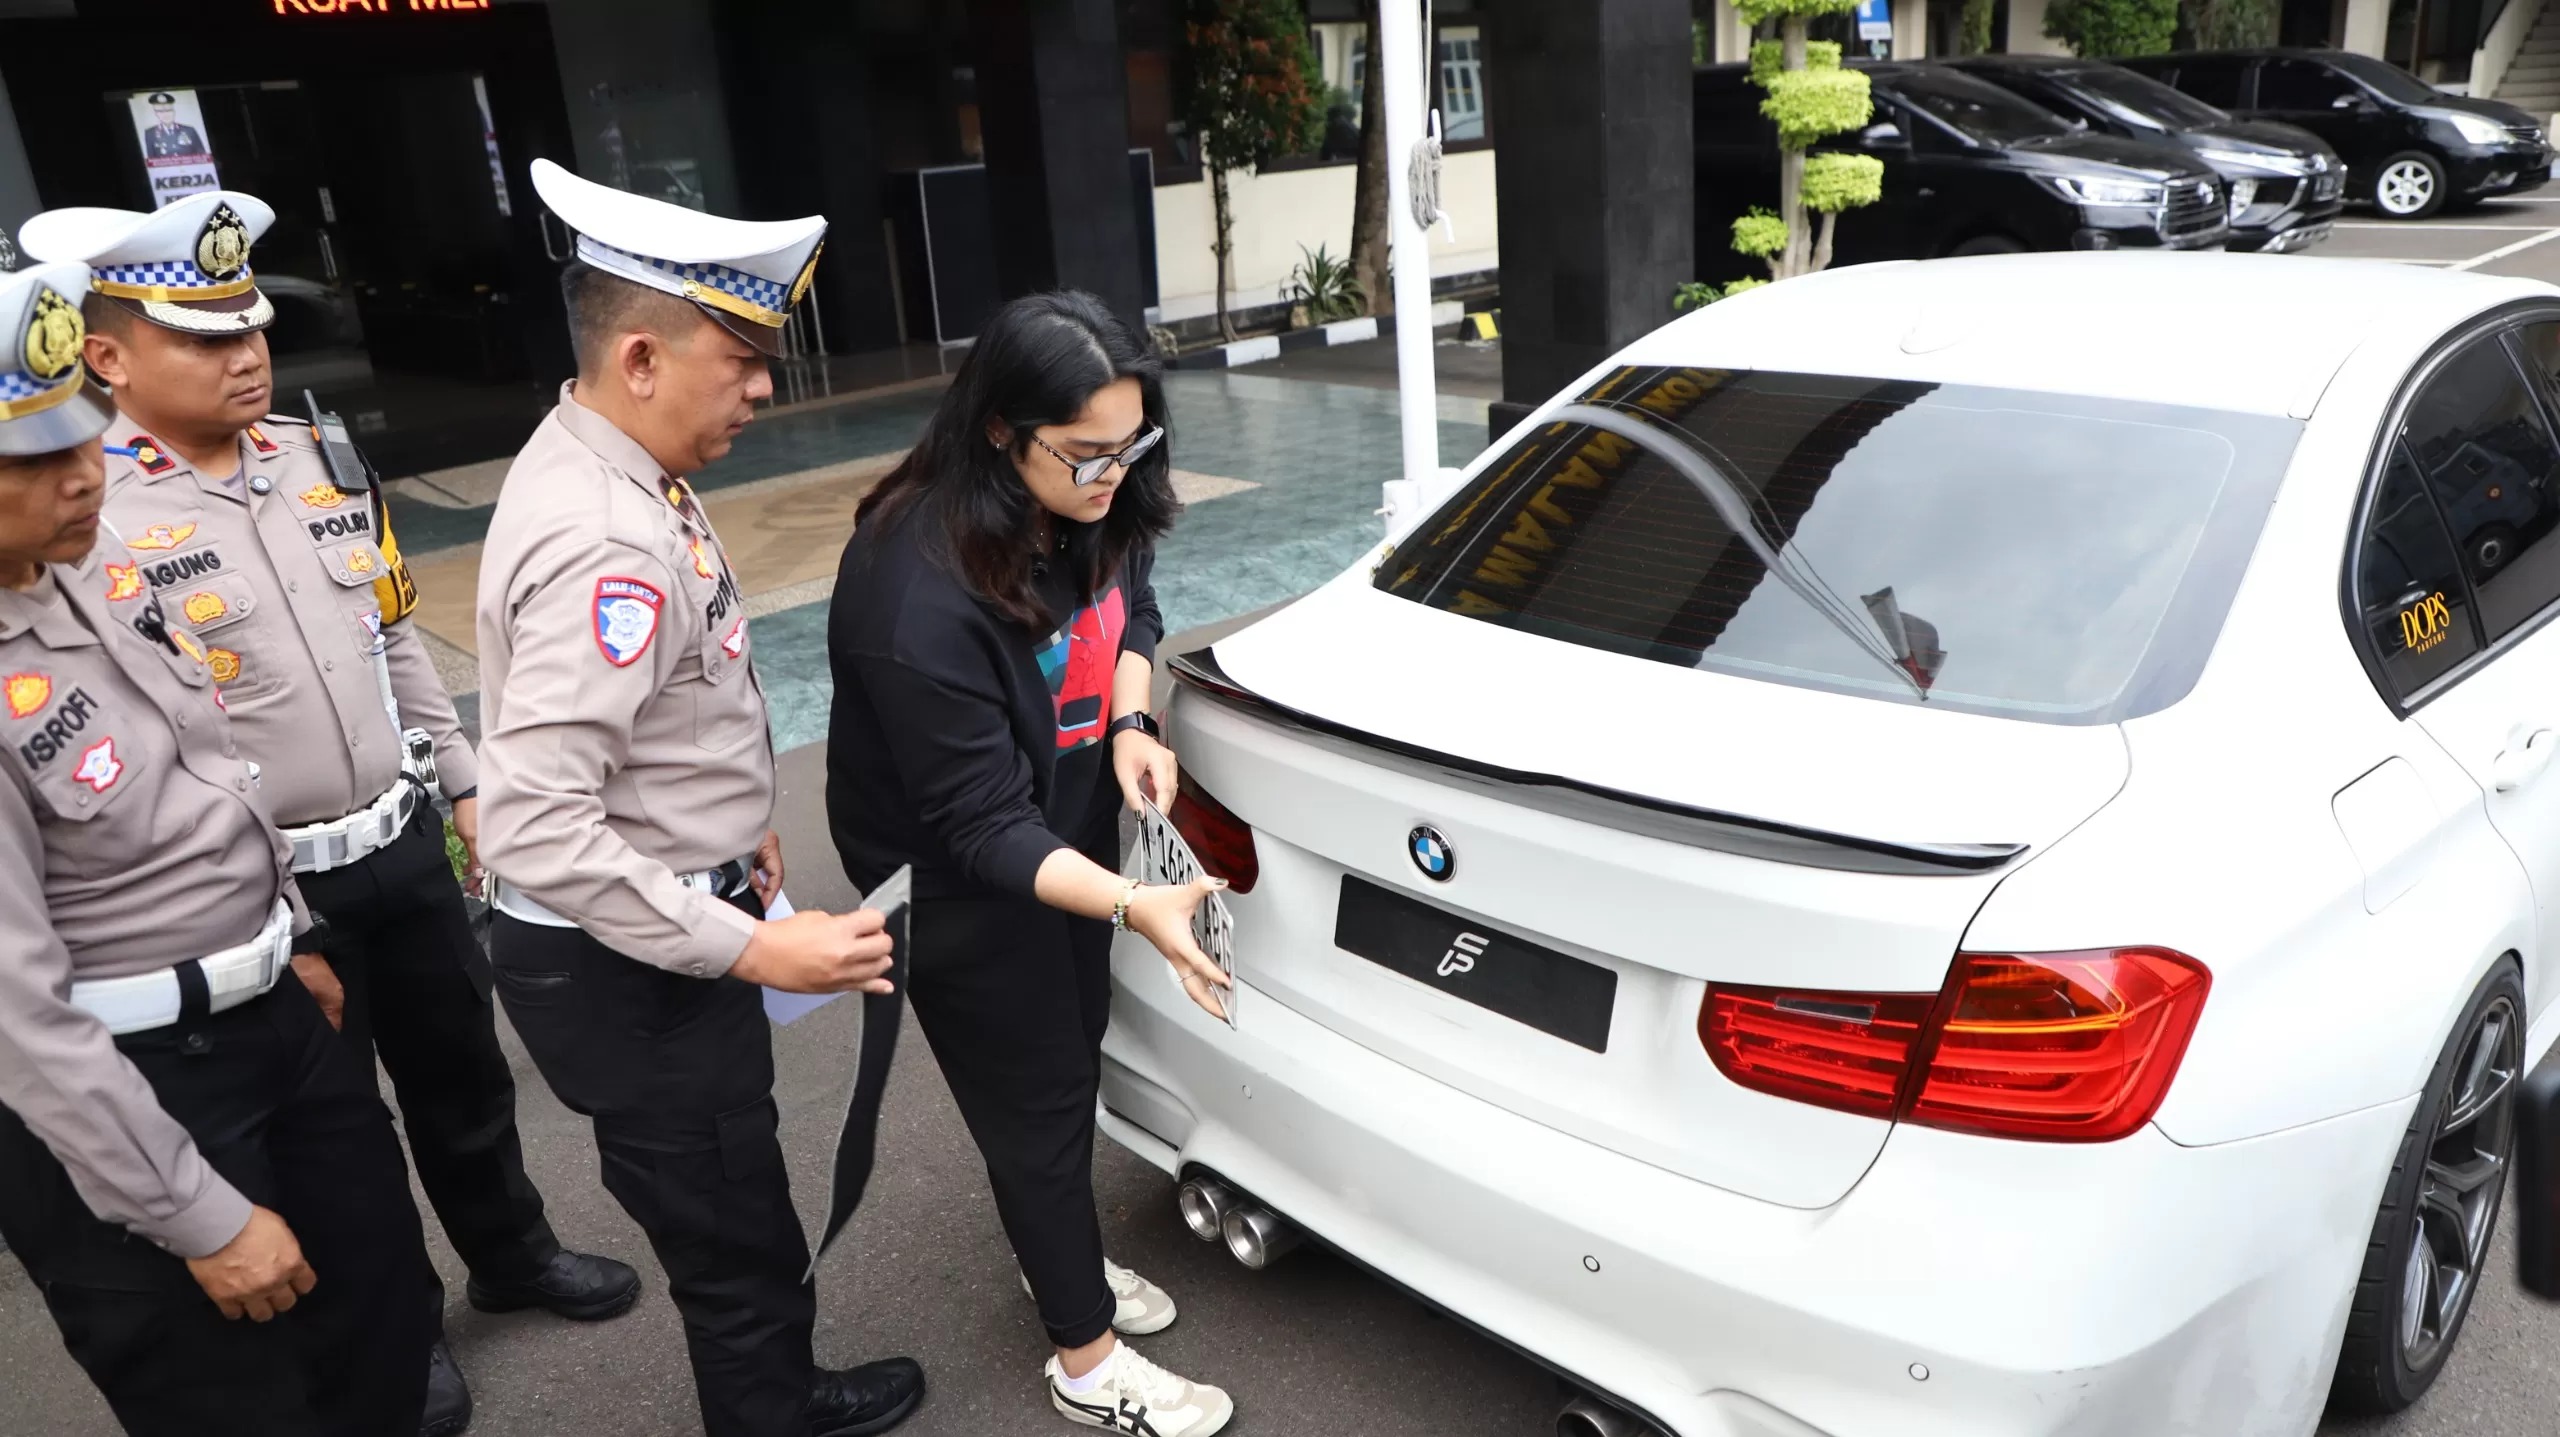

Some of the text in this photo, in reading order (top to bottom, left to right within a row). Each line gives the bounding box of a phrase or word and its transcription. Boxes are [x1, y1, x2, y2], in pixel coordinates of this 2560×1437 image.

[155, 174, 217, 190] KERJA
[308, 511, 370, 542] POLRI
[143, 550, 221, 588] AGUNG
[2401, 591, 2450, 649] DOPS
[20, 686, 99, 771] ISROFI
[1411, 827, 1450, 851] BMW
